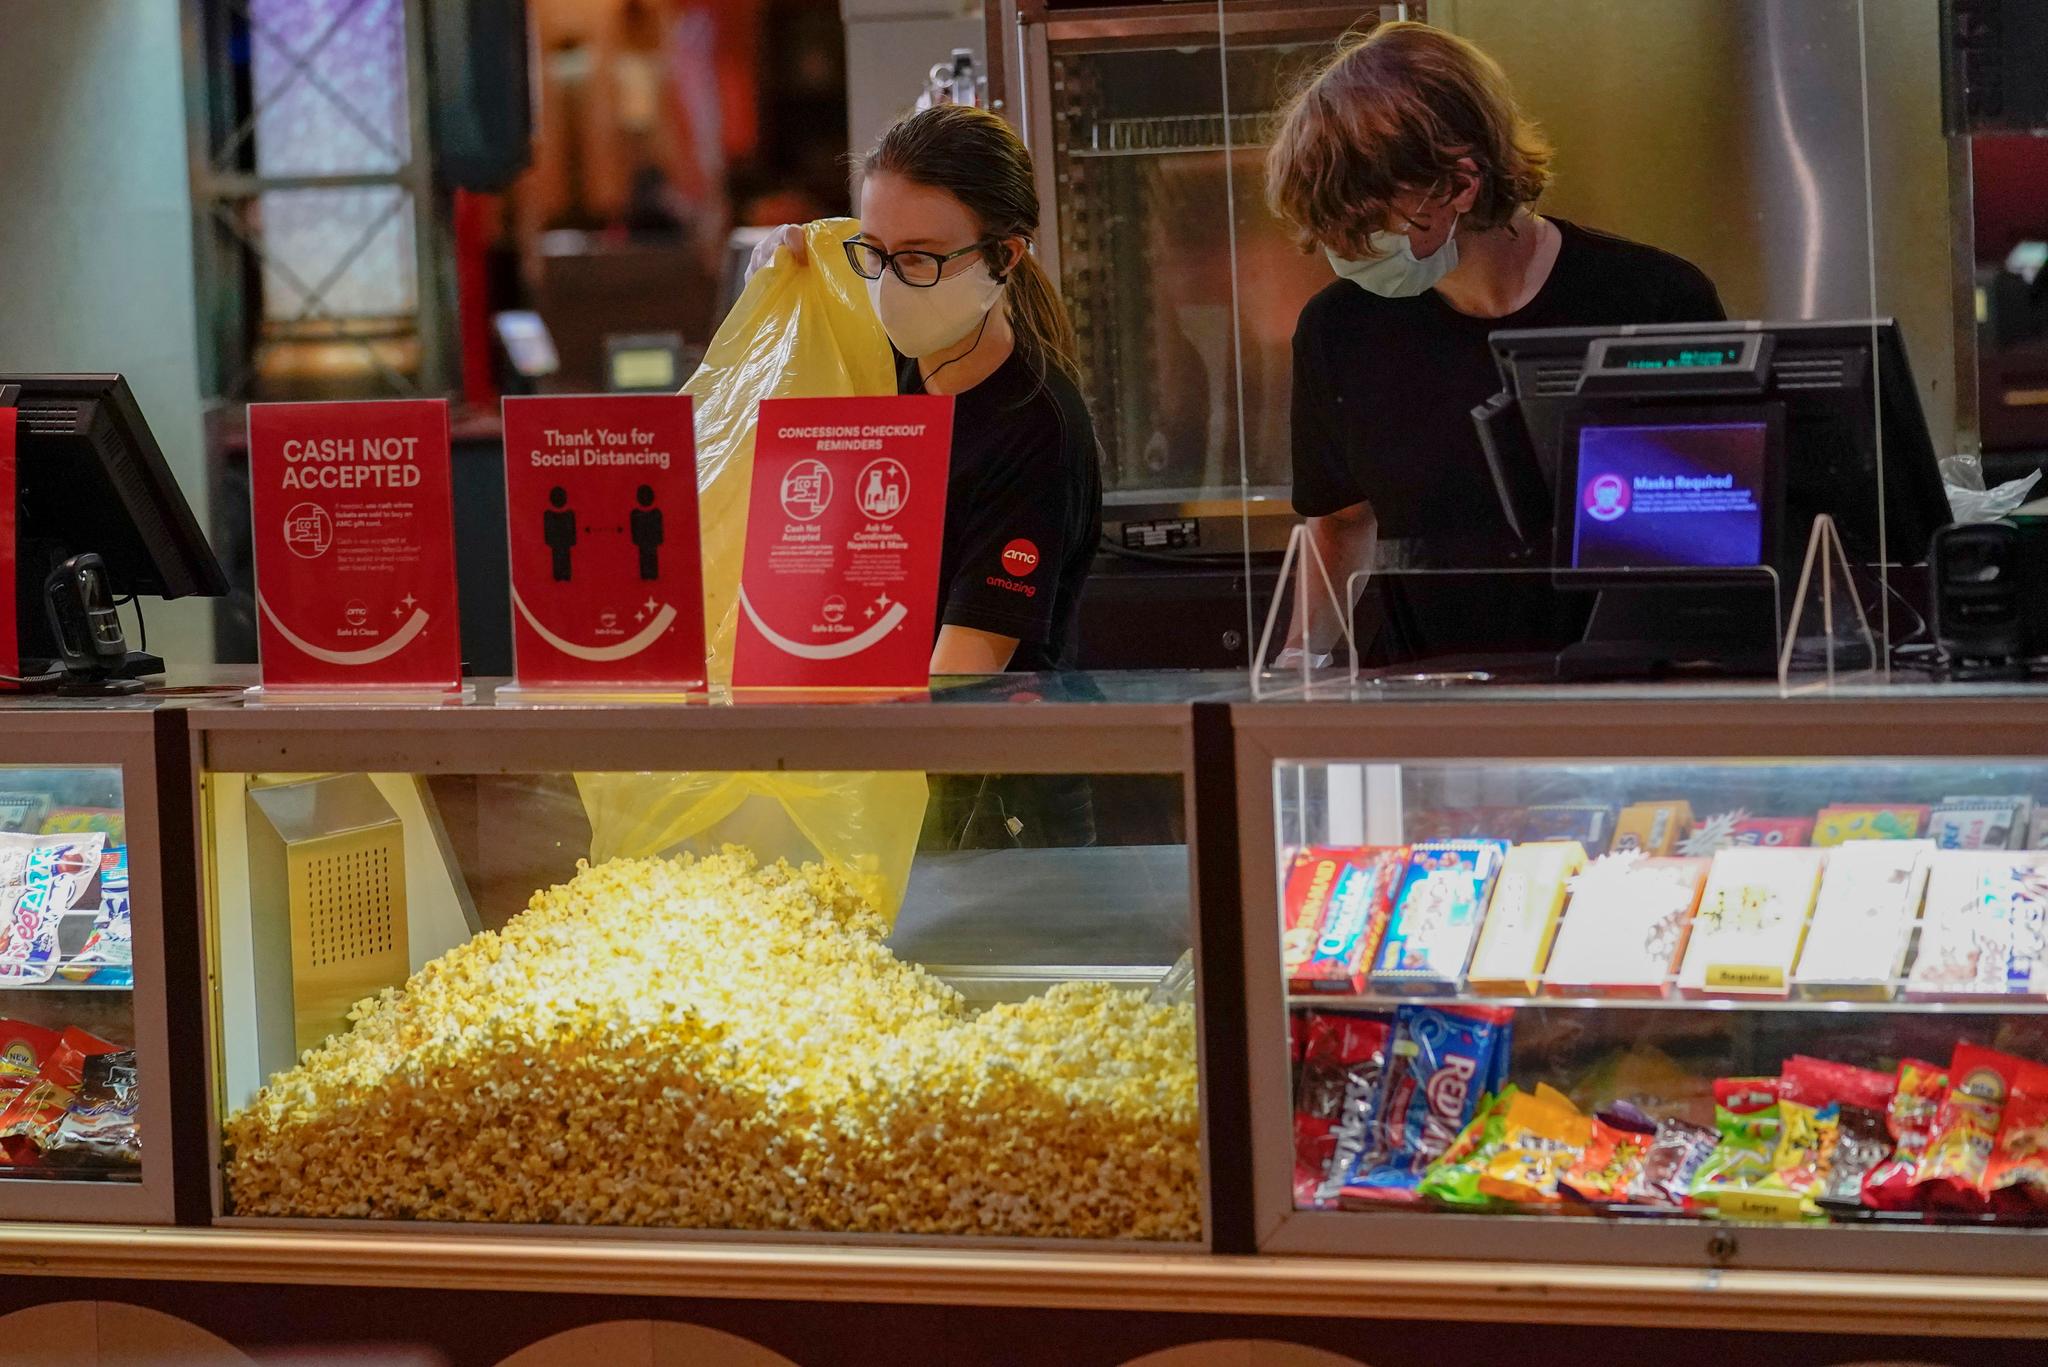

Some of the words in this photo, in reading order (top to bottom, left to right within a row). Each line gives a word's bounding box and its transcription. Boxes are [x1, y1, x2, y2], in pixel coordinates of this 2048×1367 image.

[544, 430, 593, 446] Thank
[597, 429, 627, 445] You
[631, 428, 655, 444] for
[779, 426, 860, 438] CONCESSIONS
[862, 425, 926, 437] CHECKOUT
[283, 439, 354, 463] CASH
[362, 437, 419, 462] NOT
[817, 439, 882, 451] REMINDERS
[531, 450, 580, 467] Social
[584, 448, 670, 470] Distancing
[282, 464, 421, 489] ACCEPTED
[1675, 473, 1733, 492] Required
[785, 524, 804, 533] Cash
[865, 523, 880, 532] Ask
[881, 523, 894, 532] for
[782, 533, 821, 544] Accepted
[887, 541, 909, 550] More
[1003, 549, 1036, 564] amc
[986, 576, 1037, 598] amazing
[9, 1052, 29, 1063] NEW
[1742, 1200, 1778, 1216] Large
